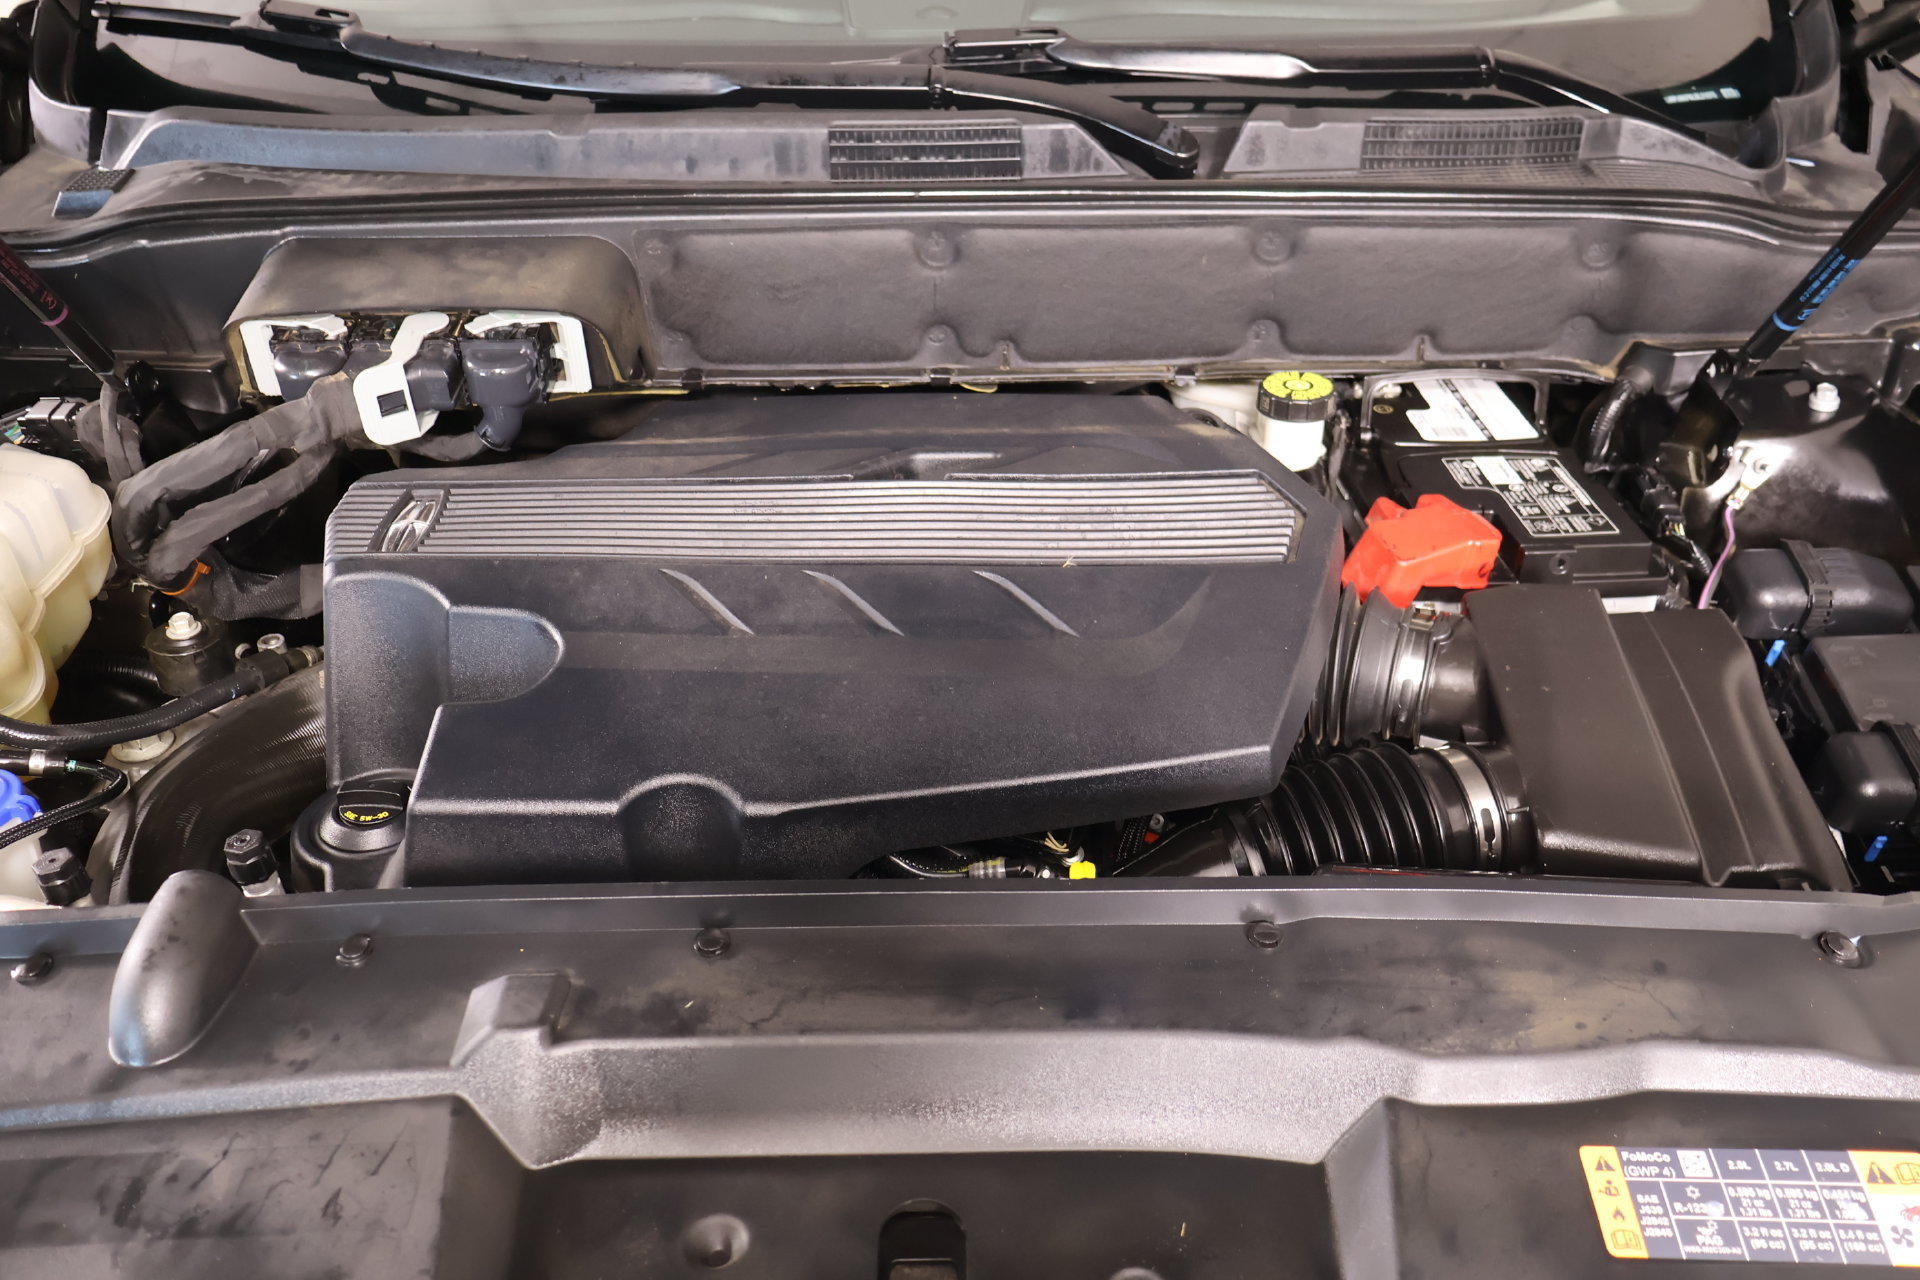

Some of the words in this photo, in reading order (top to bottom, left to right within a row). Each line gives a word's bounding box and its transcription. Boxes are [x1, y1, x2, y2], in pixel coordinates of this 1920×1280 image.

[360, 811, 389, 821] 5W-30
[1621, 1151, 1671, 1163] FoMoCo
[1624, 1165, 1660, 1179] (GWP
[1662, 1166, 1676, 1179] 4)
[1774, 1160, 1799, 1172] 2.7L
[1840, 1162, 1850, 1173] D
[1755, 1187, 1771, 1201] kg
[1803, 1188, 1819, 1202] kg
[1850, 1190, 1867, 1203] kg
[1673, 1201, 1725, 1217] R-123
[1696, 1234, 1724, 1246] PAG
